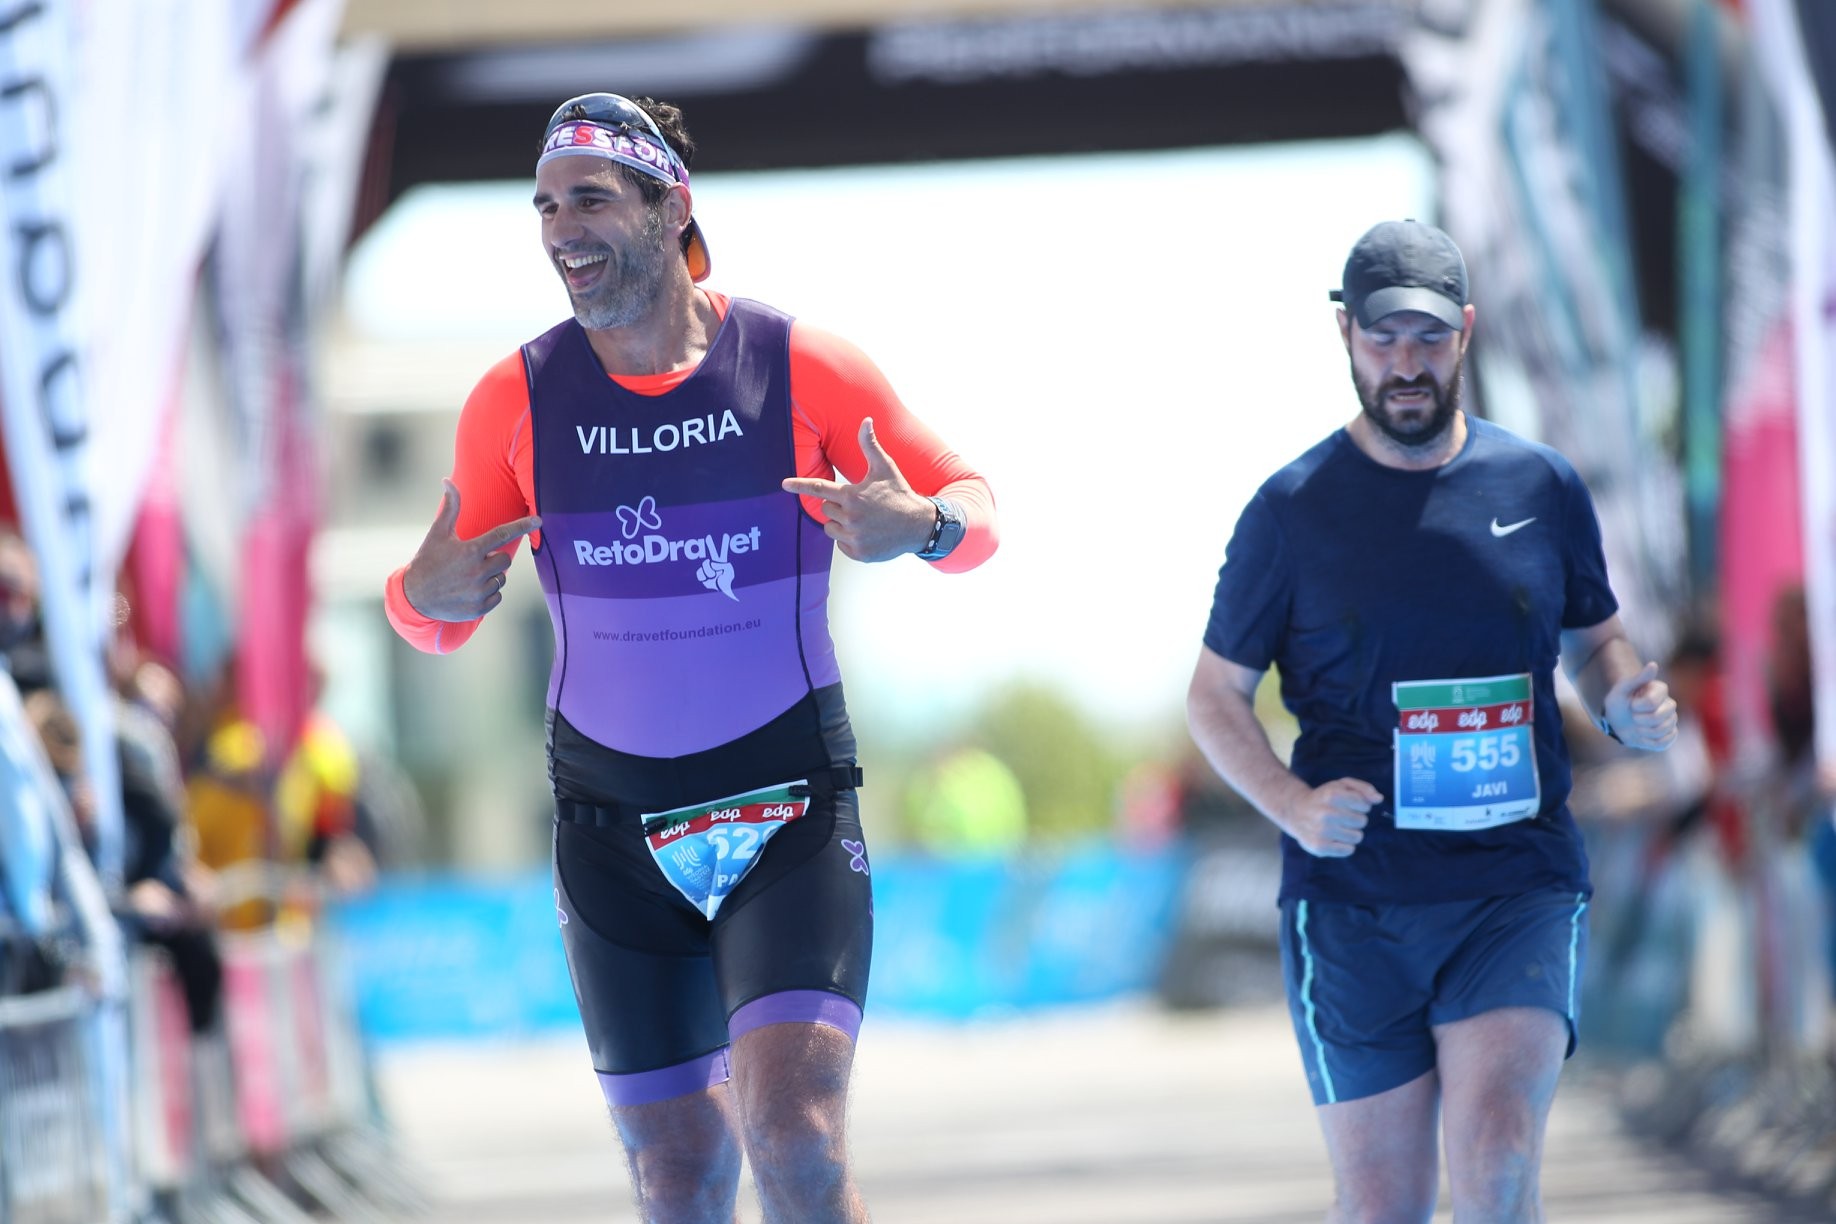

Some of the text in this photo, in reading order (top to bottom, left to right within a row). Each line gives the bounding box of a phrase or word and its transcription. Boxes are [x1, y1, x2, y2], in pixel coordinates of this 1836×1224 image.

[576, 409, 743, 454] VILLORIA
[573, 526, 761, 565] RetoDravet
[593, 618, 761, 642] www.dravetfoundation.eu
[1408, 704, 1523, 733] edp edp edp
[1451, 733, 1520, 772] 555
[1472, 781, 1508, 798] JAVI
[710, 808, 741, 822] edp
[762, 804, 794, 821] edp
